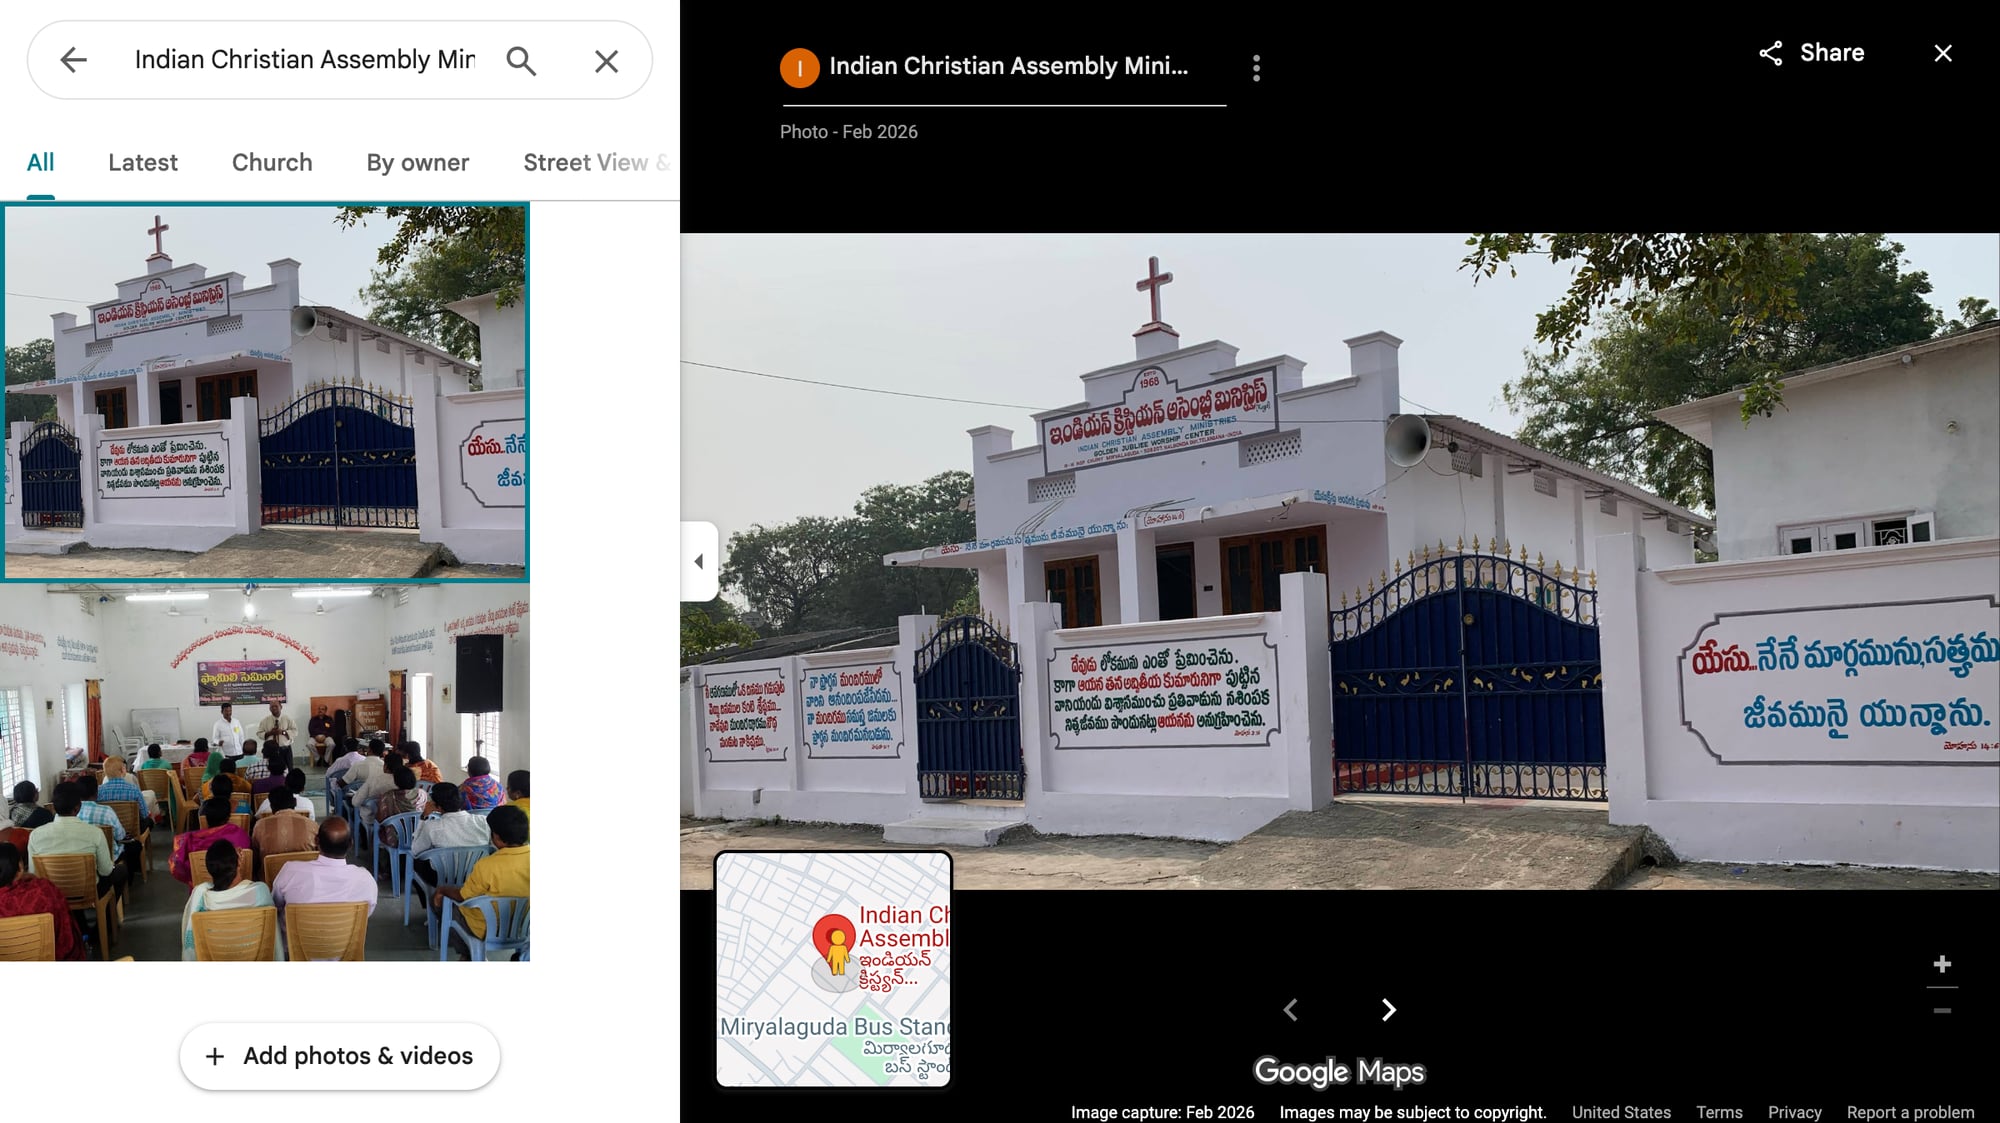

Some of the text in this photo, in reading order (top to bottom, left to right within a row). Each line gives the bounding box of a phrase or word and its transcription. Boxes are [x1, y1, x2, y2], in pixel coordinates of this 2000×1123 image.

[135, 47, 205, 70] Indian
[211, 47, 314, 70] Christian
[319, 47, 432, 75] Assembly
[1800, 41, 1865, 63] Share
[830, 54, 1189, 81] Indian Christian Assembly Mini...
[780, 123, 829, 140] Photo
[842, 123, 873, 140] Feb
[876, 124, 919, 140] 2026
[26, 151, 55, 172] All
[109, 152, 179, 172] Latest
[232, 151, 313, 172] Church
[367, 152, 471, 177] By owner
[523, 151, 671, 172] Street View &
[1140, 376, 1160, 388] 1968
[1049, 411, 1112, 446] ఇండియన్
[1113, 399, 1165, 437] క్రిస్టియన్
[1077, 415, 1237, 453] INDIAN CHRISTIAN ASSEMBLY MINISTRIES
[1093, 446, 1119, 457] GOLDEN
[1151, 434, 1181, 447] WORSHIP
[1184, 428, 1215, 441] CENTER
[1070, 654, 1097, 675] దేవుడు
[1100, 650, 1139, 672] లోకమును
[1142, 648, 1170, 670] ఎంతో
[1053, 665, 1260, 694] కాగా ఆయన తన అద్వితీయ కుమారునిగా పుట్టిన
[1054, 696, 1102, 712] వానియందు
[1226, 689, 1270, 706] నశింపక
[1157, 712, 1195, 729] ఆయనను
[1743, 694, 1849, 740] జీవమునై
[860, 905, 922, 924] Indian
[859, 949, 932, 967] ఇండియన్
[721, 1017, 847, 1040] Miryalaguda
[854, 1017, 893, 1036] Bus
[242, 1044, 474, 1070] Add photos & videos
[885, 1055, 912, 1073] బస్
[1255, 1058, 1424, 1089] Google Maps
[1071, 1104, 1256, 1123] Image capture: Feb 2026
[1279, 1104, 1546, 1123] Images may be subject to copyright.
[1572, 1104, 1672, 1120] United States
[1695, 1105, 1744, 1120] Terms
[1768, 1104, 1823, 1123] Privacy
[1847, 1104, 1975, 1123] Report a problem
